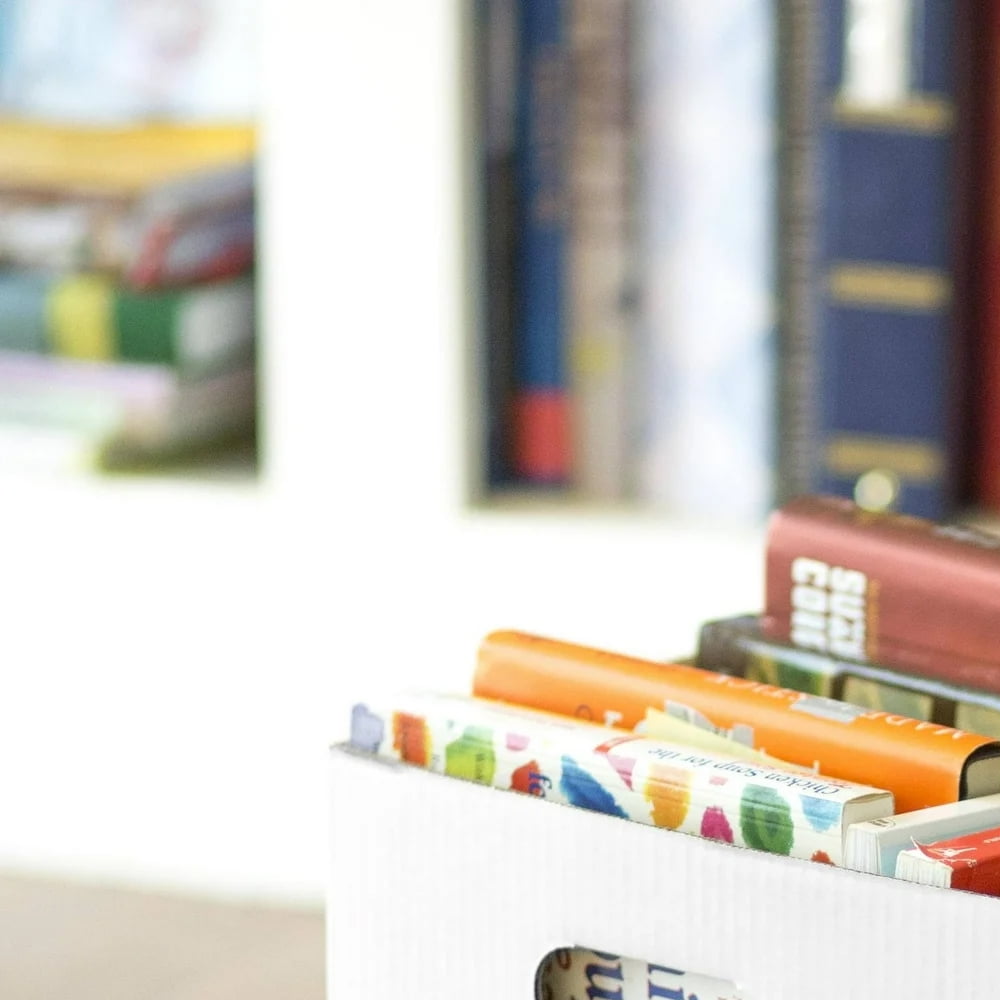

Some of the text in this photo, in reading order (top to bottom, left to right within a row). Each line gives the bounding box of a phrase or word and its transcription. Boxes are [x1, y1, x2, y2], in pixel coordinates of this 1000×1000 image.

[648, 748, 841, 796] Chicken Soup for the
